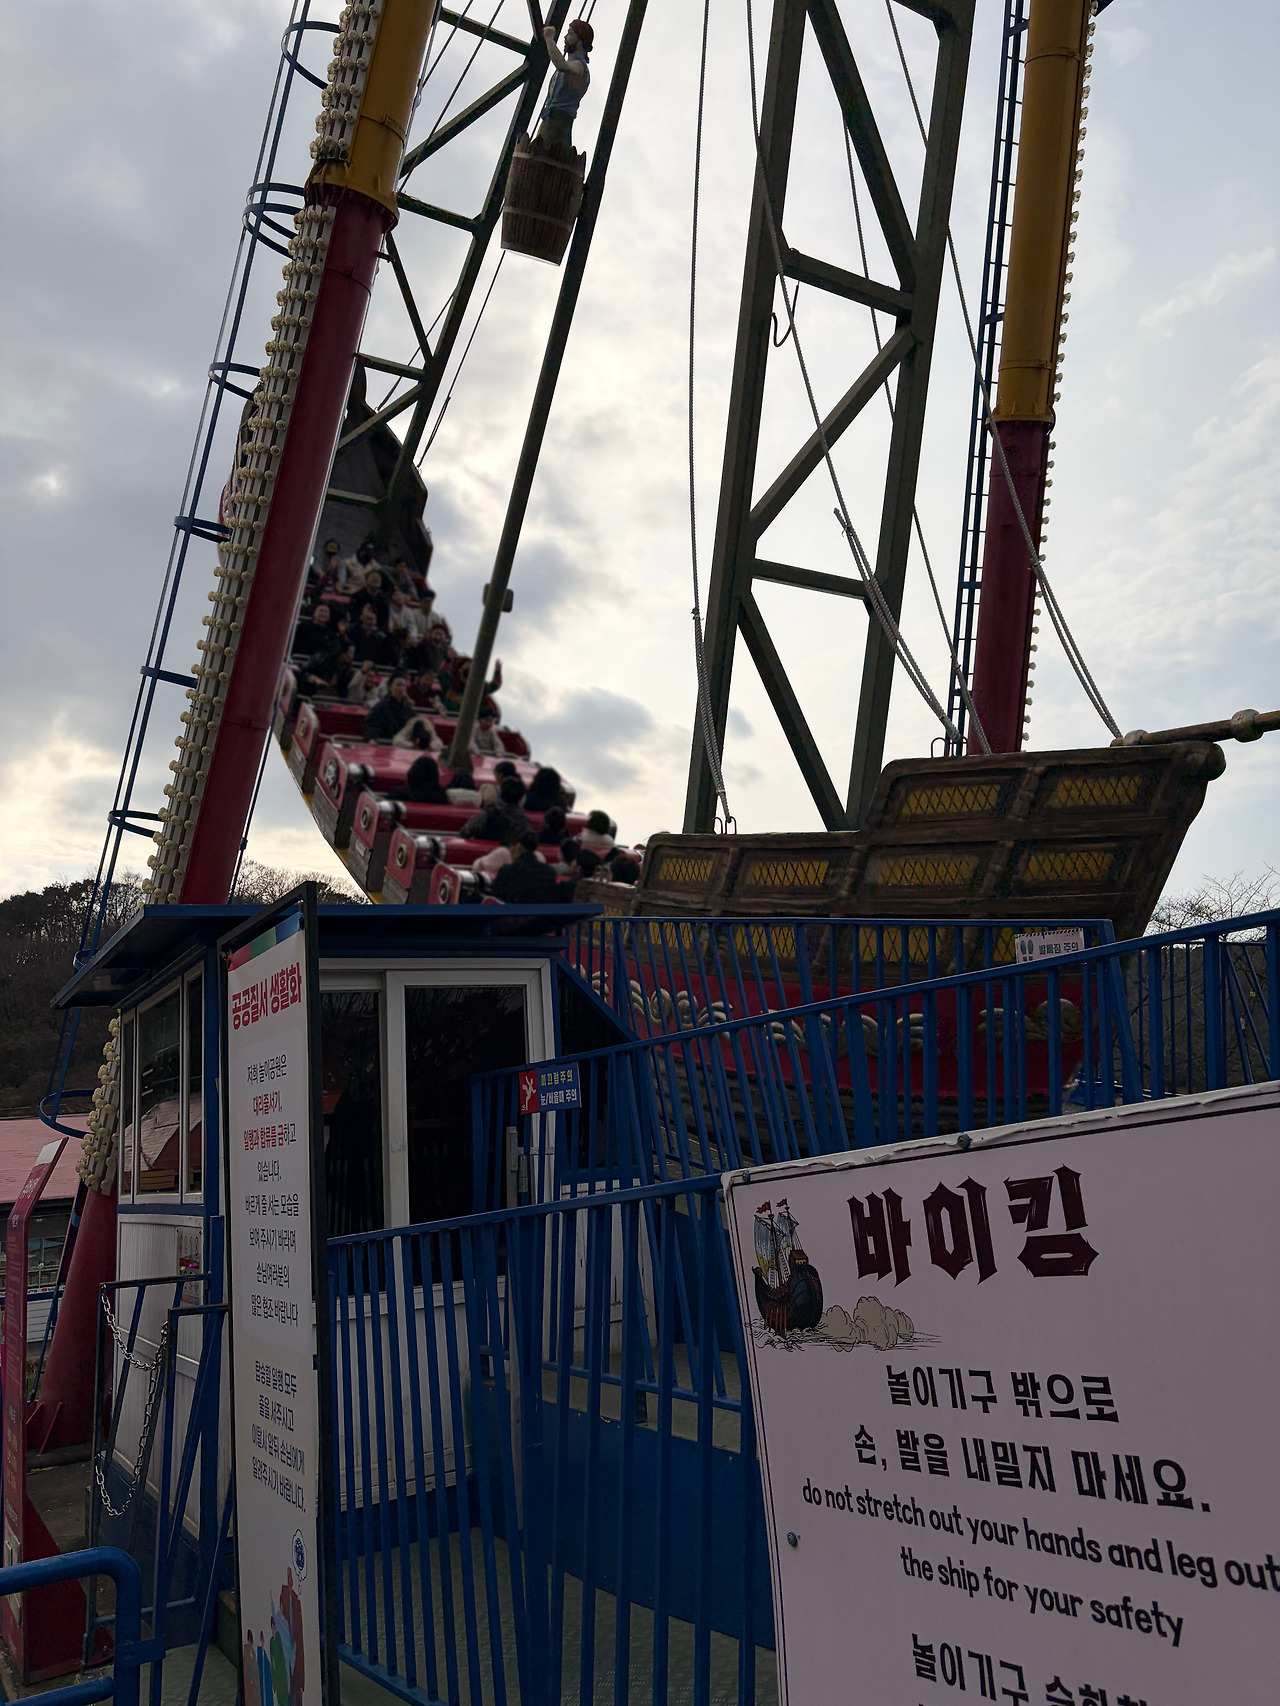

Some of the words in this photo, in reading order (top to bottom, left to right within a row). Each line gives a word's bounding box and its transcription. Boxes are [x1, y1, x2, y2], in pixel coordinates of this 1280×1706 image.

[1064, 942, 1079, 953] 주의
[232, 978, 268, 1030] 공공질서
[270, 962, 302, 1014] 생활화
[259, 1054, 287, 1082] 놀이공원은
[565, 1088, 577, 1102] 주의
[244, 1129, 259, 1151] 일행과
[260, 1126, 277, 1148] 합류를
[278, 1123, 296, 1146] 금하고
[258, 1160, 281, 1181] 있습니다.
[281, 1193, 299, 1216] 모습을
[279, 1229, 296, 1253] 바라며
[846, 1164, 1100, 1288] 바이킹
[252, 1294, 261, 1317] 많은
[263, 1296, 274, 1319] 협조
[275, 1300, 298, 1327] 바랍니다
[255, 1360, 271, 1387] 탑승할
[272, 1367, 283, 1393] 일행
[285, 1372, 297, 1398] 모두
[886, 1365, 998, 1414] 놀이기구
[1010, 1371, 1120, 1423] 밖으로
[259, 1394, 270, 1420] 줄을
[280, 1440, 305, 1476] 손님에게
[854, 1424, 887, 1472] 손,
[896, 1428, 950, 1477] 발을
[961, 1437, 1056, 1493] 내밀지
[1071, 1449, 1211, 1513] 마세요.
[280, 1474, 306, 1513] 바랍니다.
[803, 1478, 822, 1506] do
[825, 1485, 854, 1513] not
[856, 1489, 926, 1528] stretch
[929, 1505, 964, 1536] out
[966, 1517, 1019, 1545] your
[1022, 1517, 1103, 1563] hands
[1108, 1538, 1164, 1574] and
[1166, 1540, 1218, 1589] leg
[1225, 1554, 1280, 1593] out
[900, 1546, 934, 1581] the
[937, 1556, 980, 1598] ship
[984, 1566, 1019, 1602] for
[1024, 1584, 1084, 1617] your
[1090, 1595, 1184, 1648] safety
[912, 1633, 1030, 1706] 놀이기구
